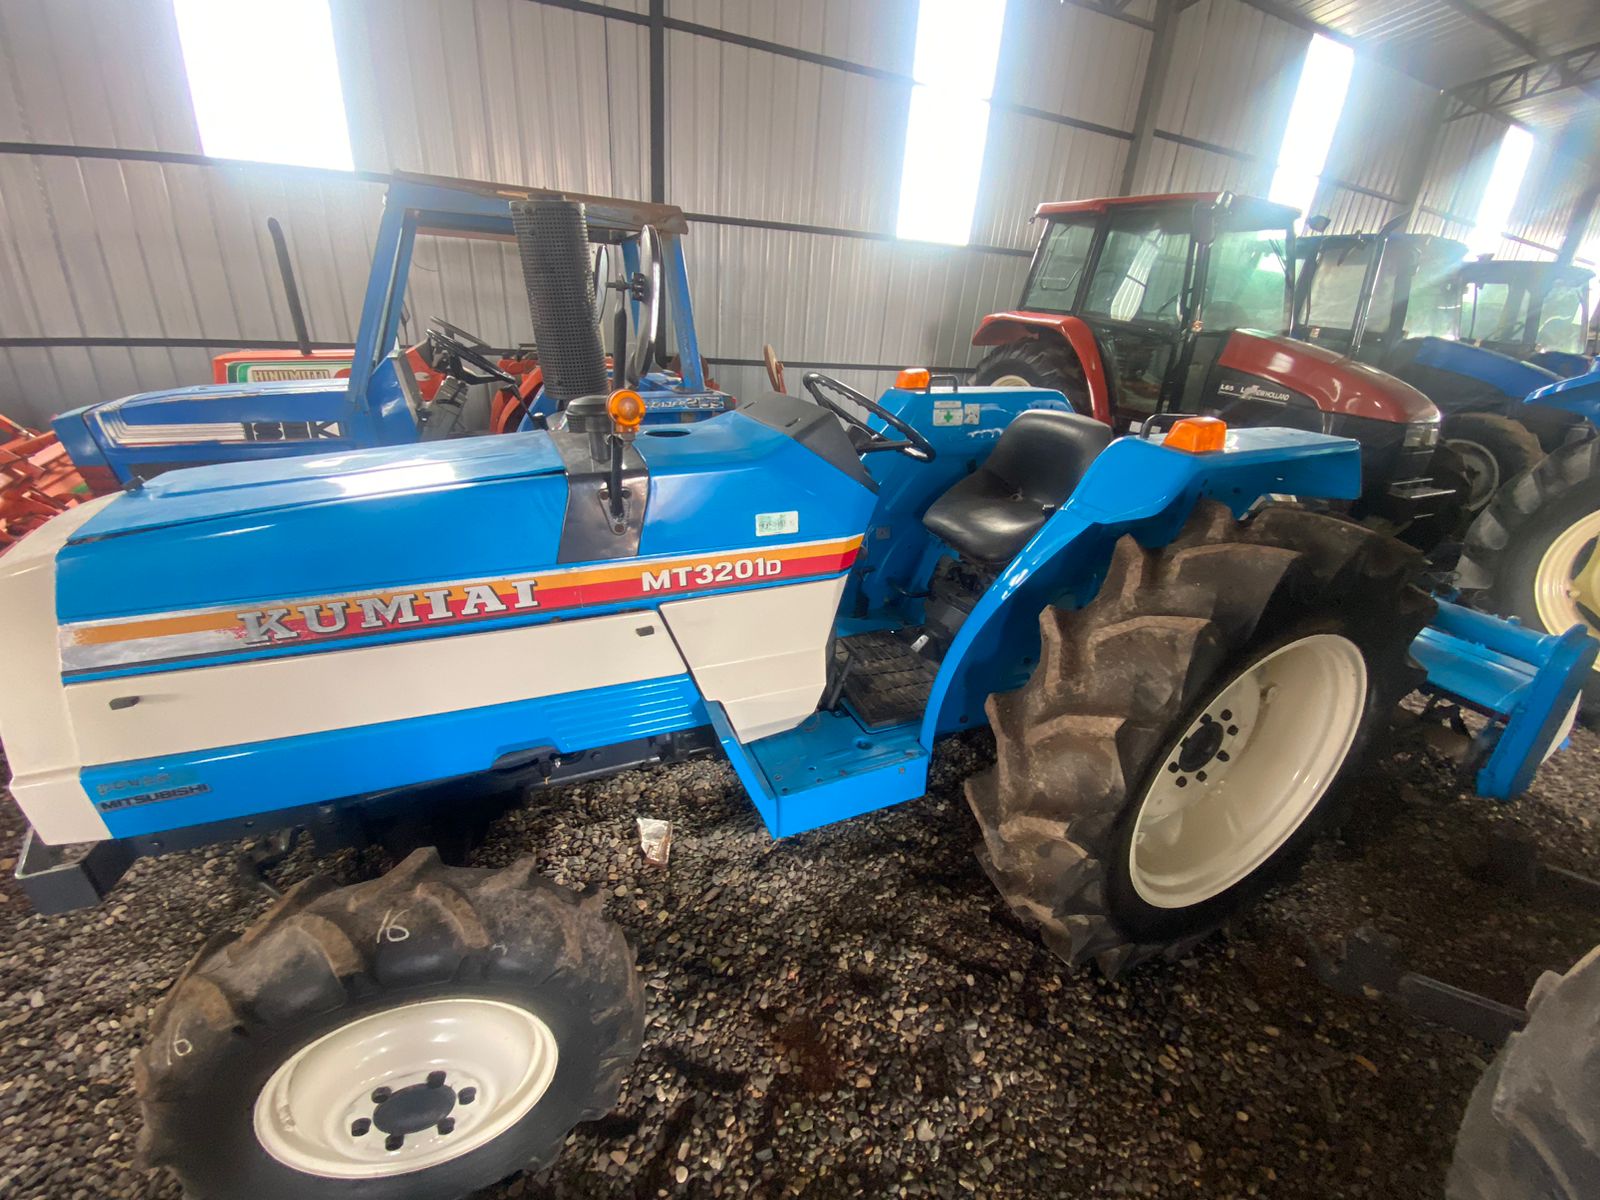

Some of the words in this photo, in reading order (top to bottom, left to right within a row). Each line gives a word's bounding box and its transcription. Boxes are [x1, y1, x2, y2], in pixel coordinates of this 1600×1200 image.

[641, 557, 782, 592] MT3201D
[236, 579, 539, 645] KUMIAI
[101, 783, 209, 810] MITSUBISHI
